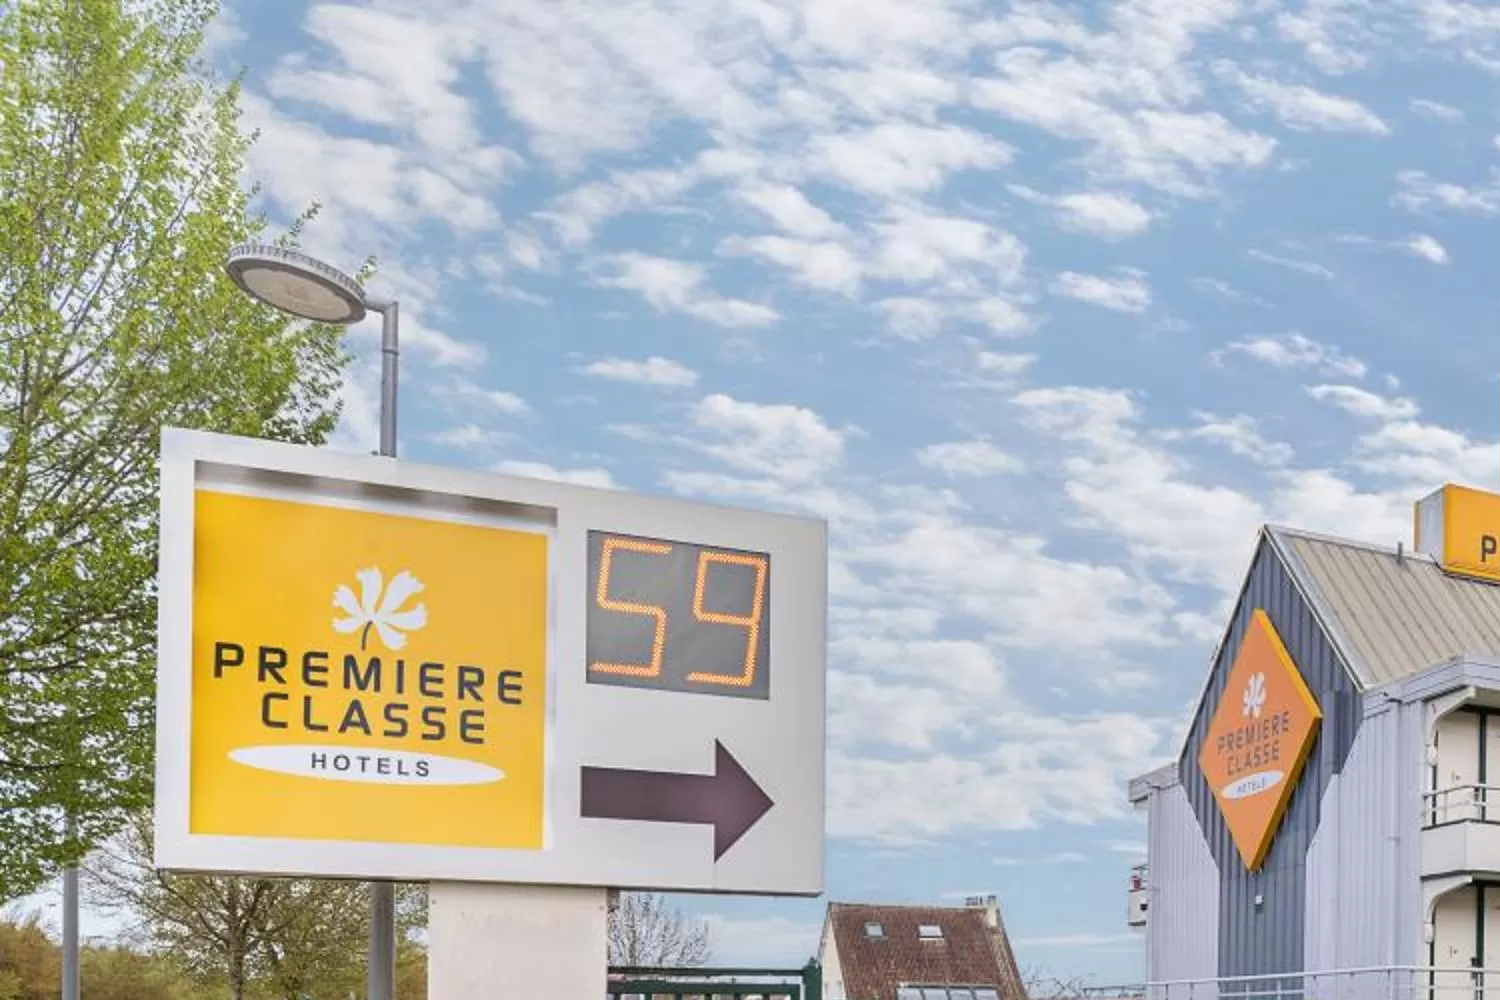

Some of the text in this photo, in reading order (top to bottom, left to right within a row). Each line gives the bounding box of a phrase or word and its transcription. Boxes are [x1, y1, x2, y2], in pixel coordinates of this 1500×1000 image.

[588, 536, 769, 688] 59
[212, 640, 524, 706] PREMIERE
[260, 691, 487, 745] CLASSE
[1216, 709, 1291, 756] PREMIERE
[310, 751, 431, 778] HOTELS
[1226, 741, 1280, 777] CLASSE
